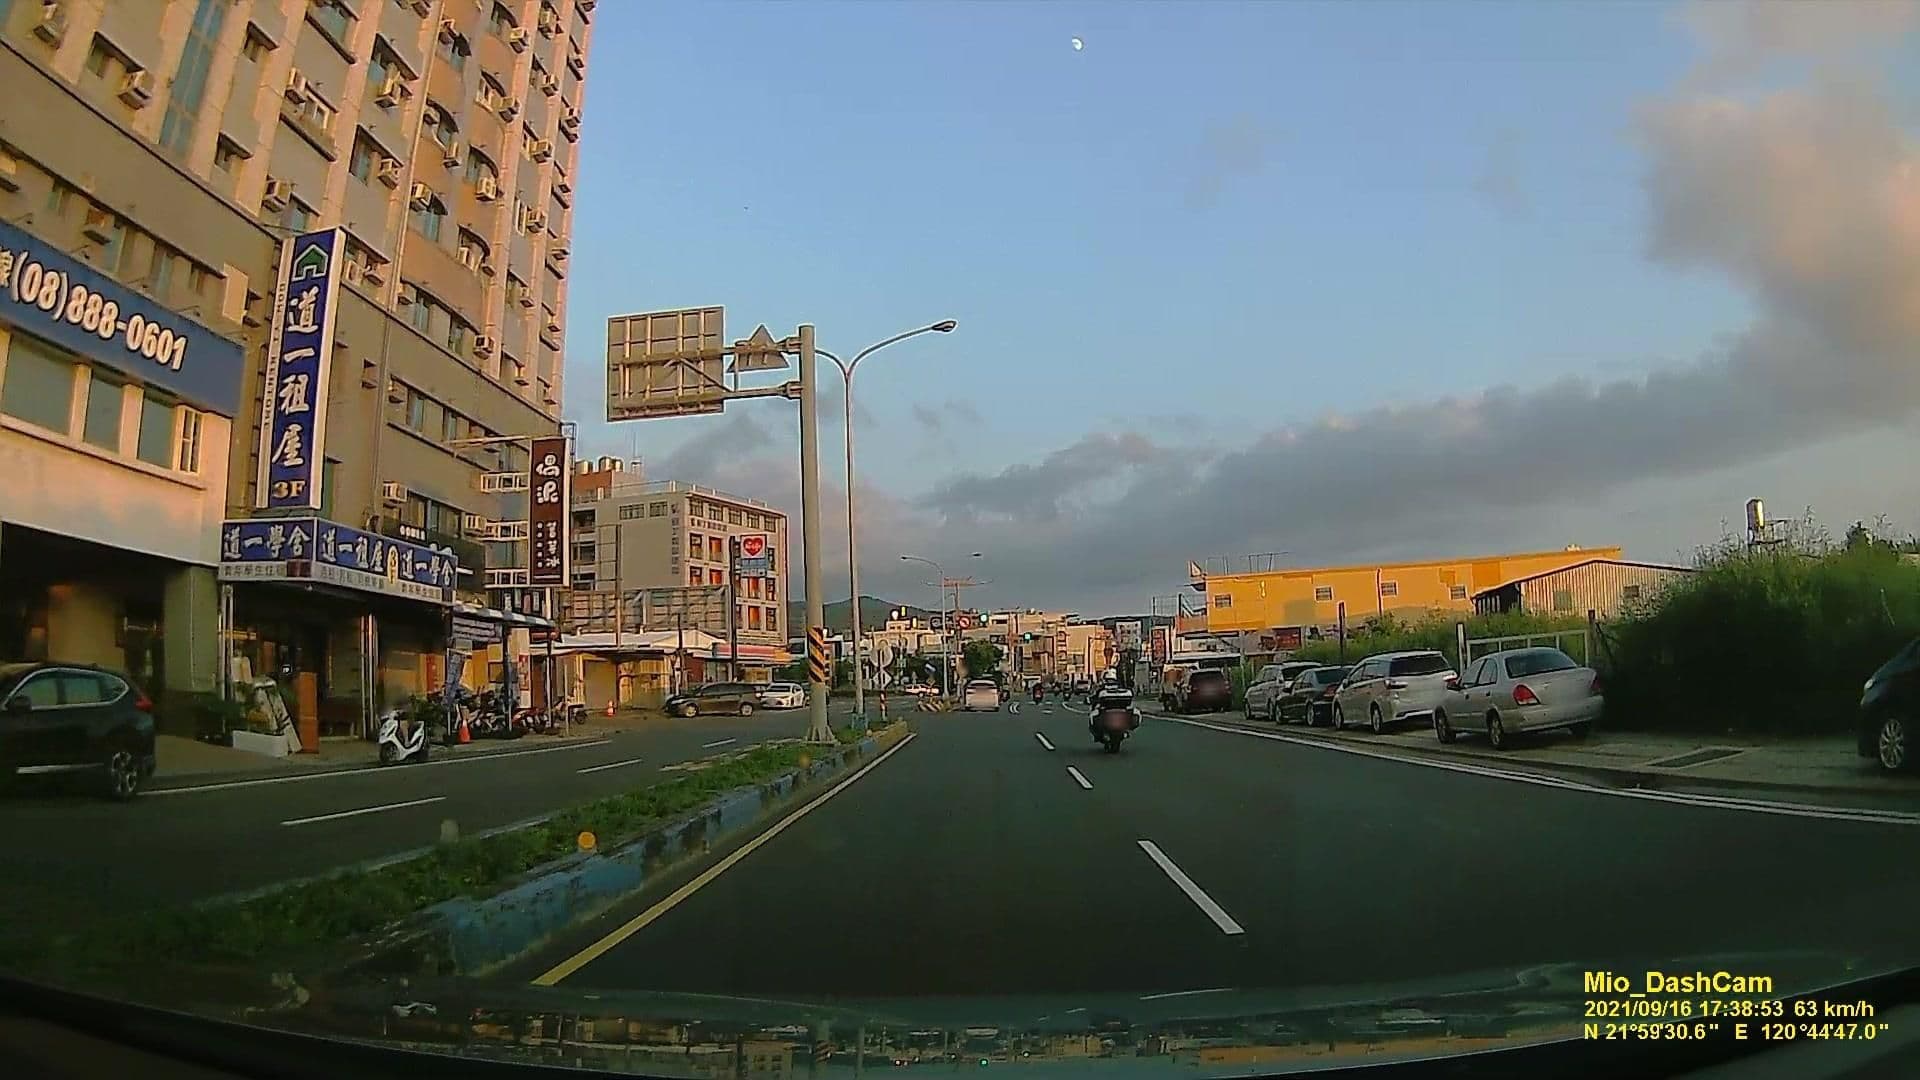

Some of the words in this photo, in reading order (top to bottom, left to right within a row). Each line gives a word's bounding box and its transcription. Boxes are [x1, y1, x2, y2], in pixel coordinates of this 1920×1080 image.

[271, 285, 319, 467] 道一租屋
[273, 480, 306, 498] 3F
[223, 524, 311, 559] 道一學舍
